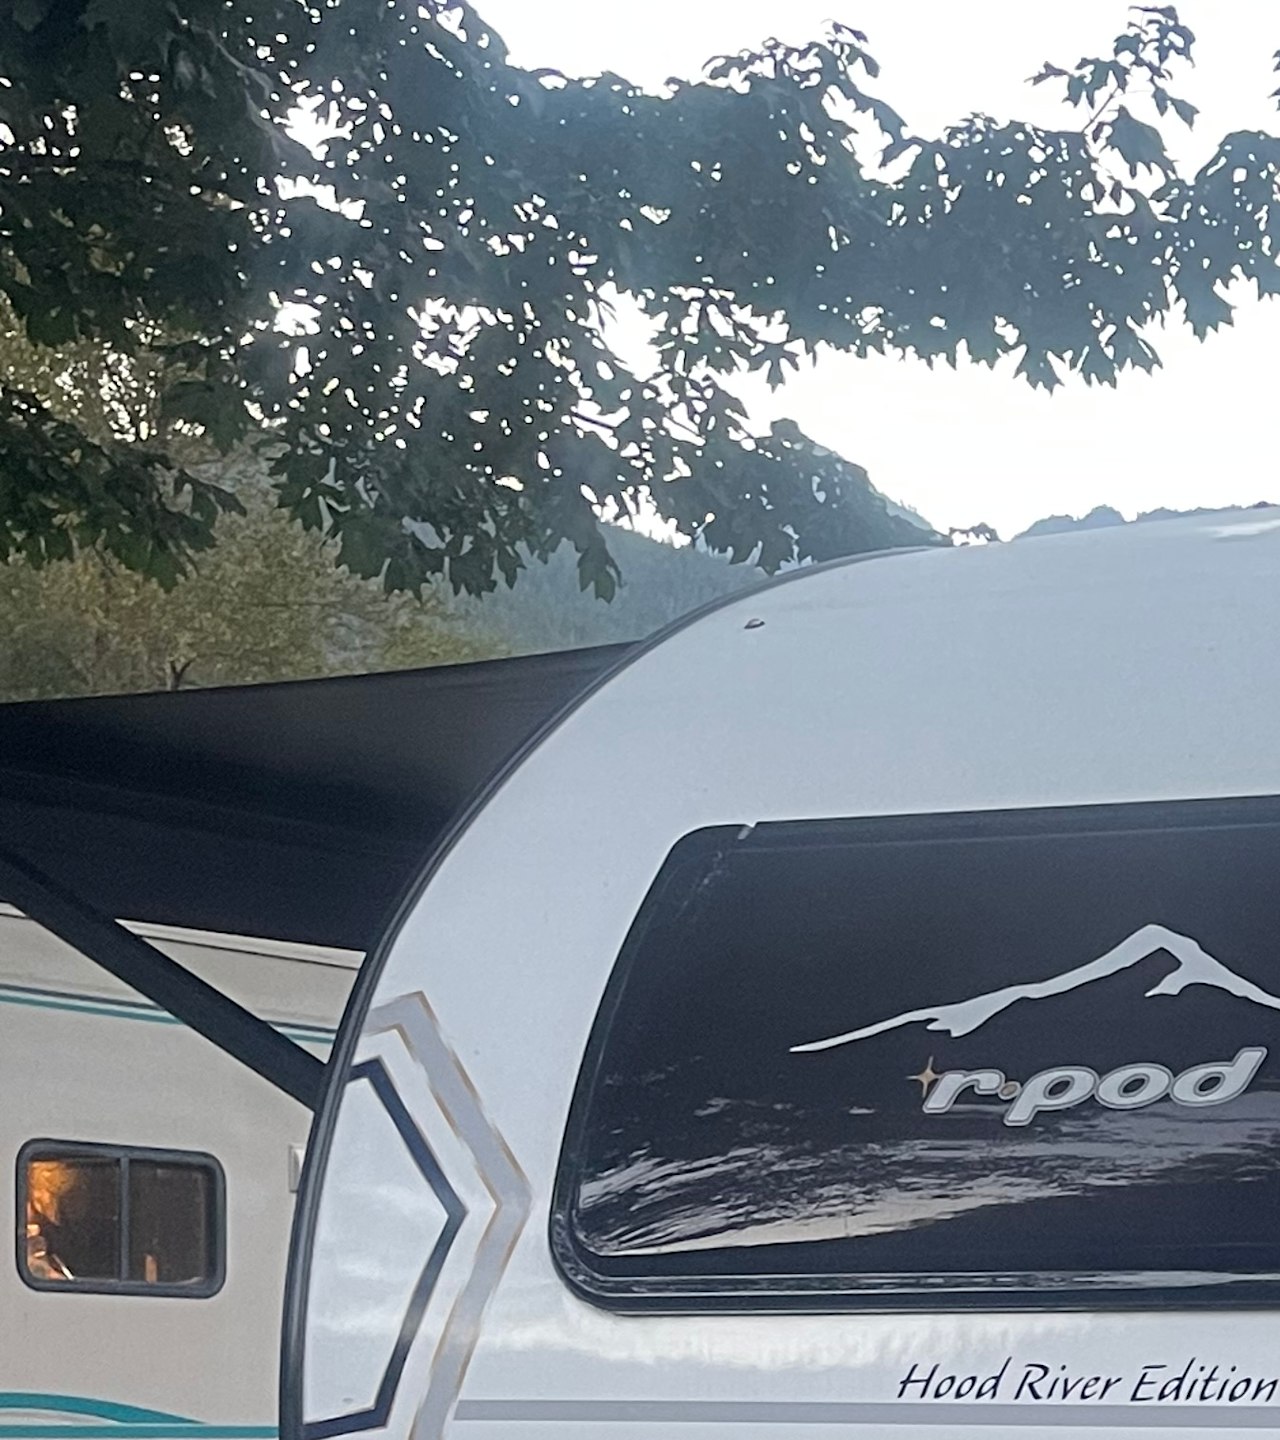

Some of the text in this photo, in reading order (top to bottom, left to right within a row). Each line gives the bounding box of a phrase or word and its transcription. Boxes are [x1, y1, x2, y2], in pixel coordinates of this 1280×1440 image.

[897, 1356, 1280, 1403] Hood River Edition
